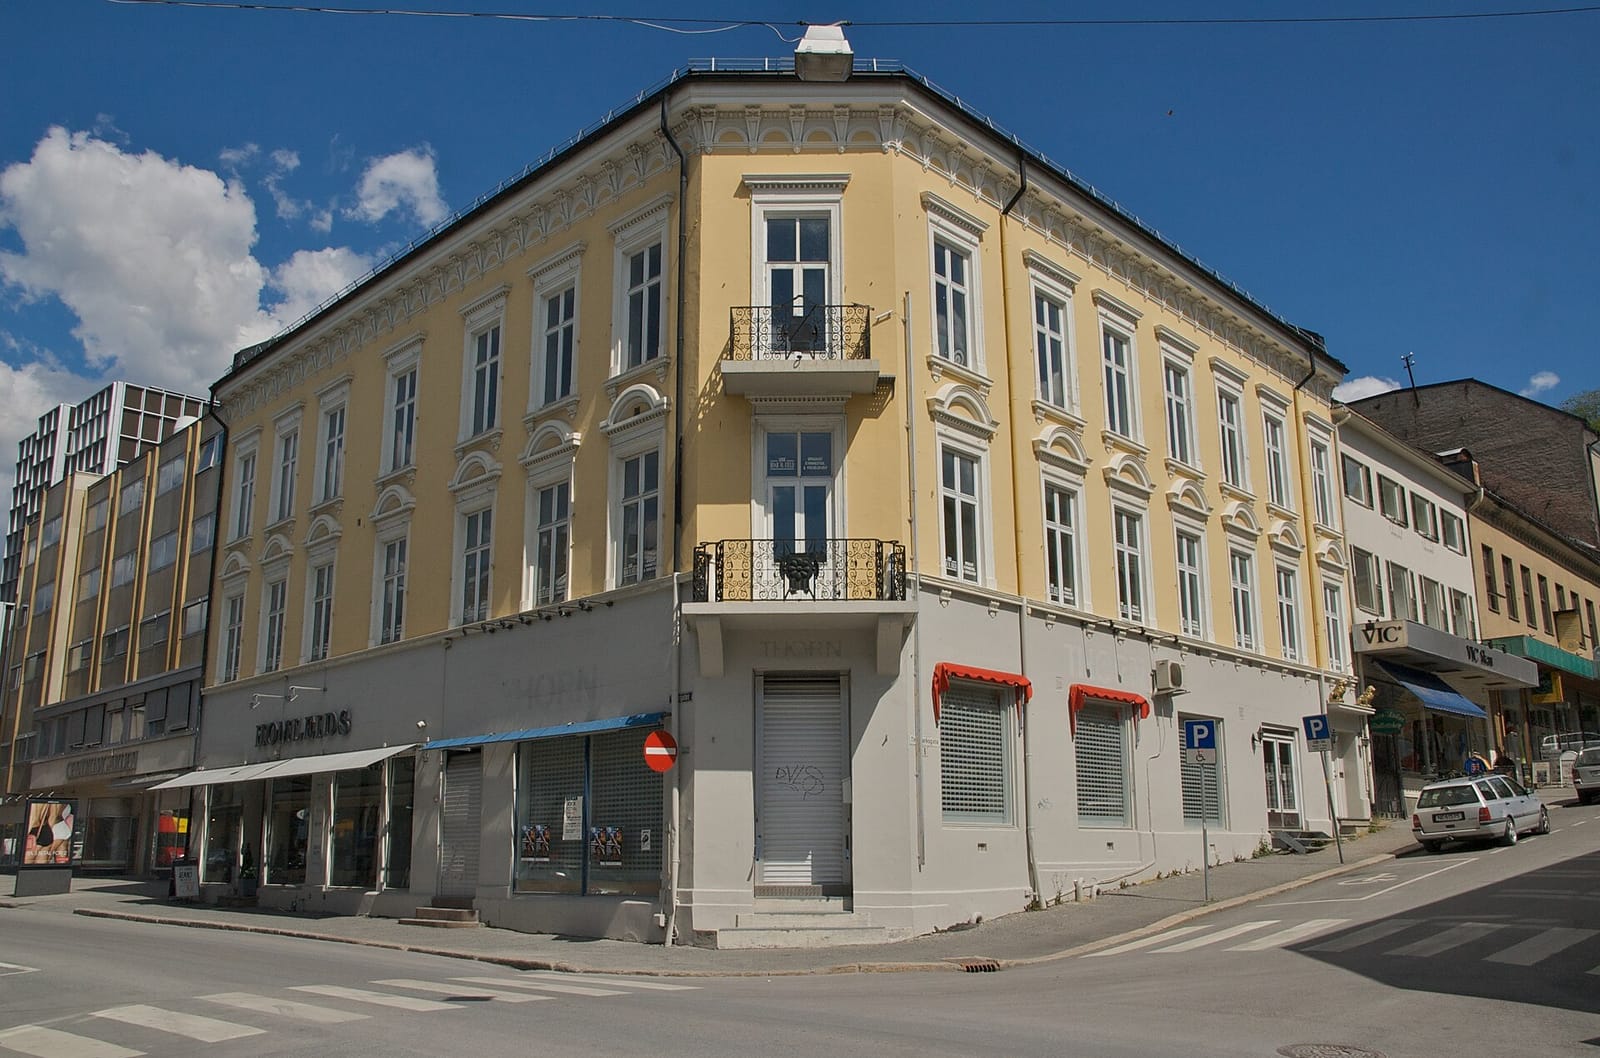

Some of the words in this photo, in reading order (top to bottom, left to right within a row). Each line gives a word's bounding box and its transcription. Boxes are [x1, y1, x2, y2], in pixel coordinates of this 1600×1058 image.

[1361, 625, 1402, 644] VIC
[1193, 725, 1209, 748] P
[1310, 719, 1324, 739] P
